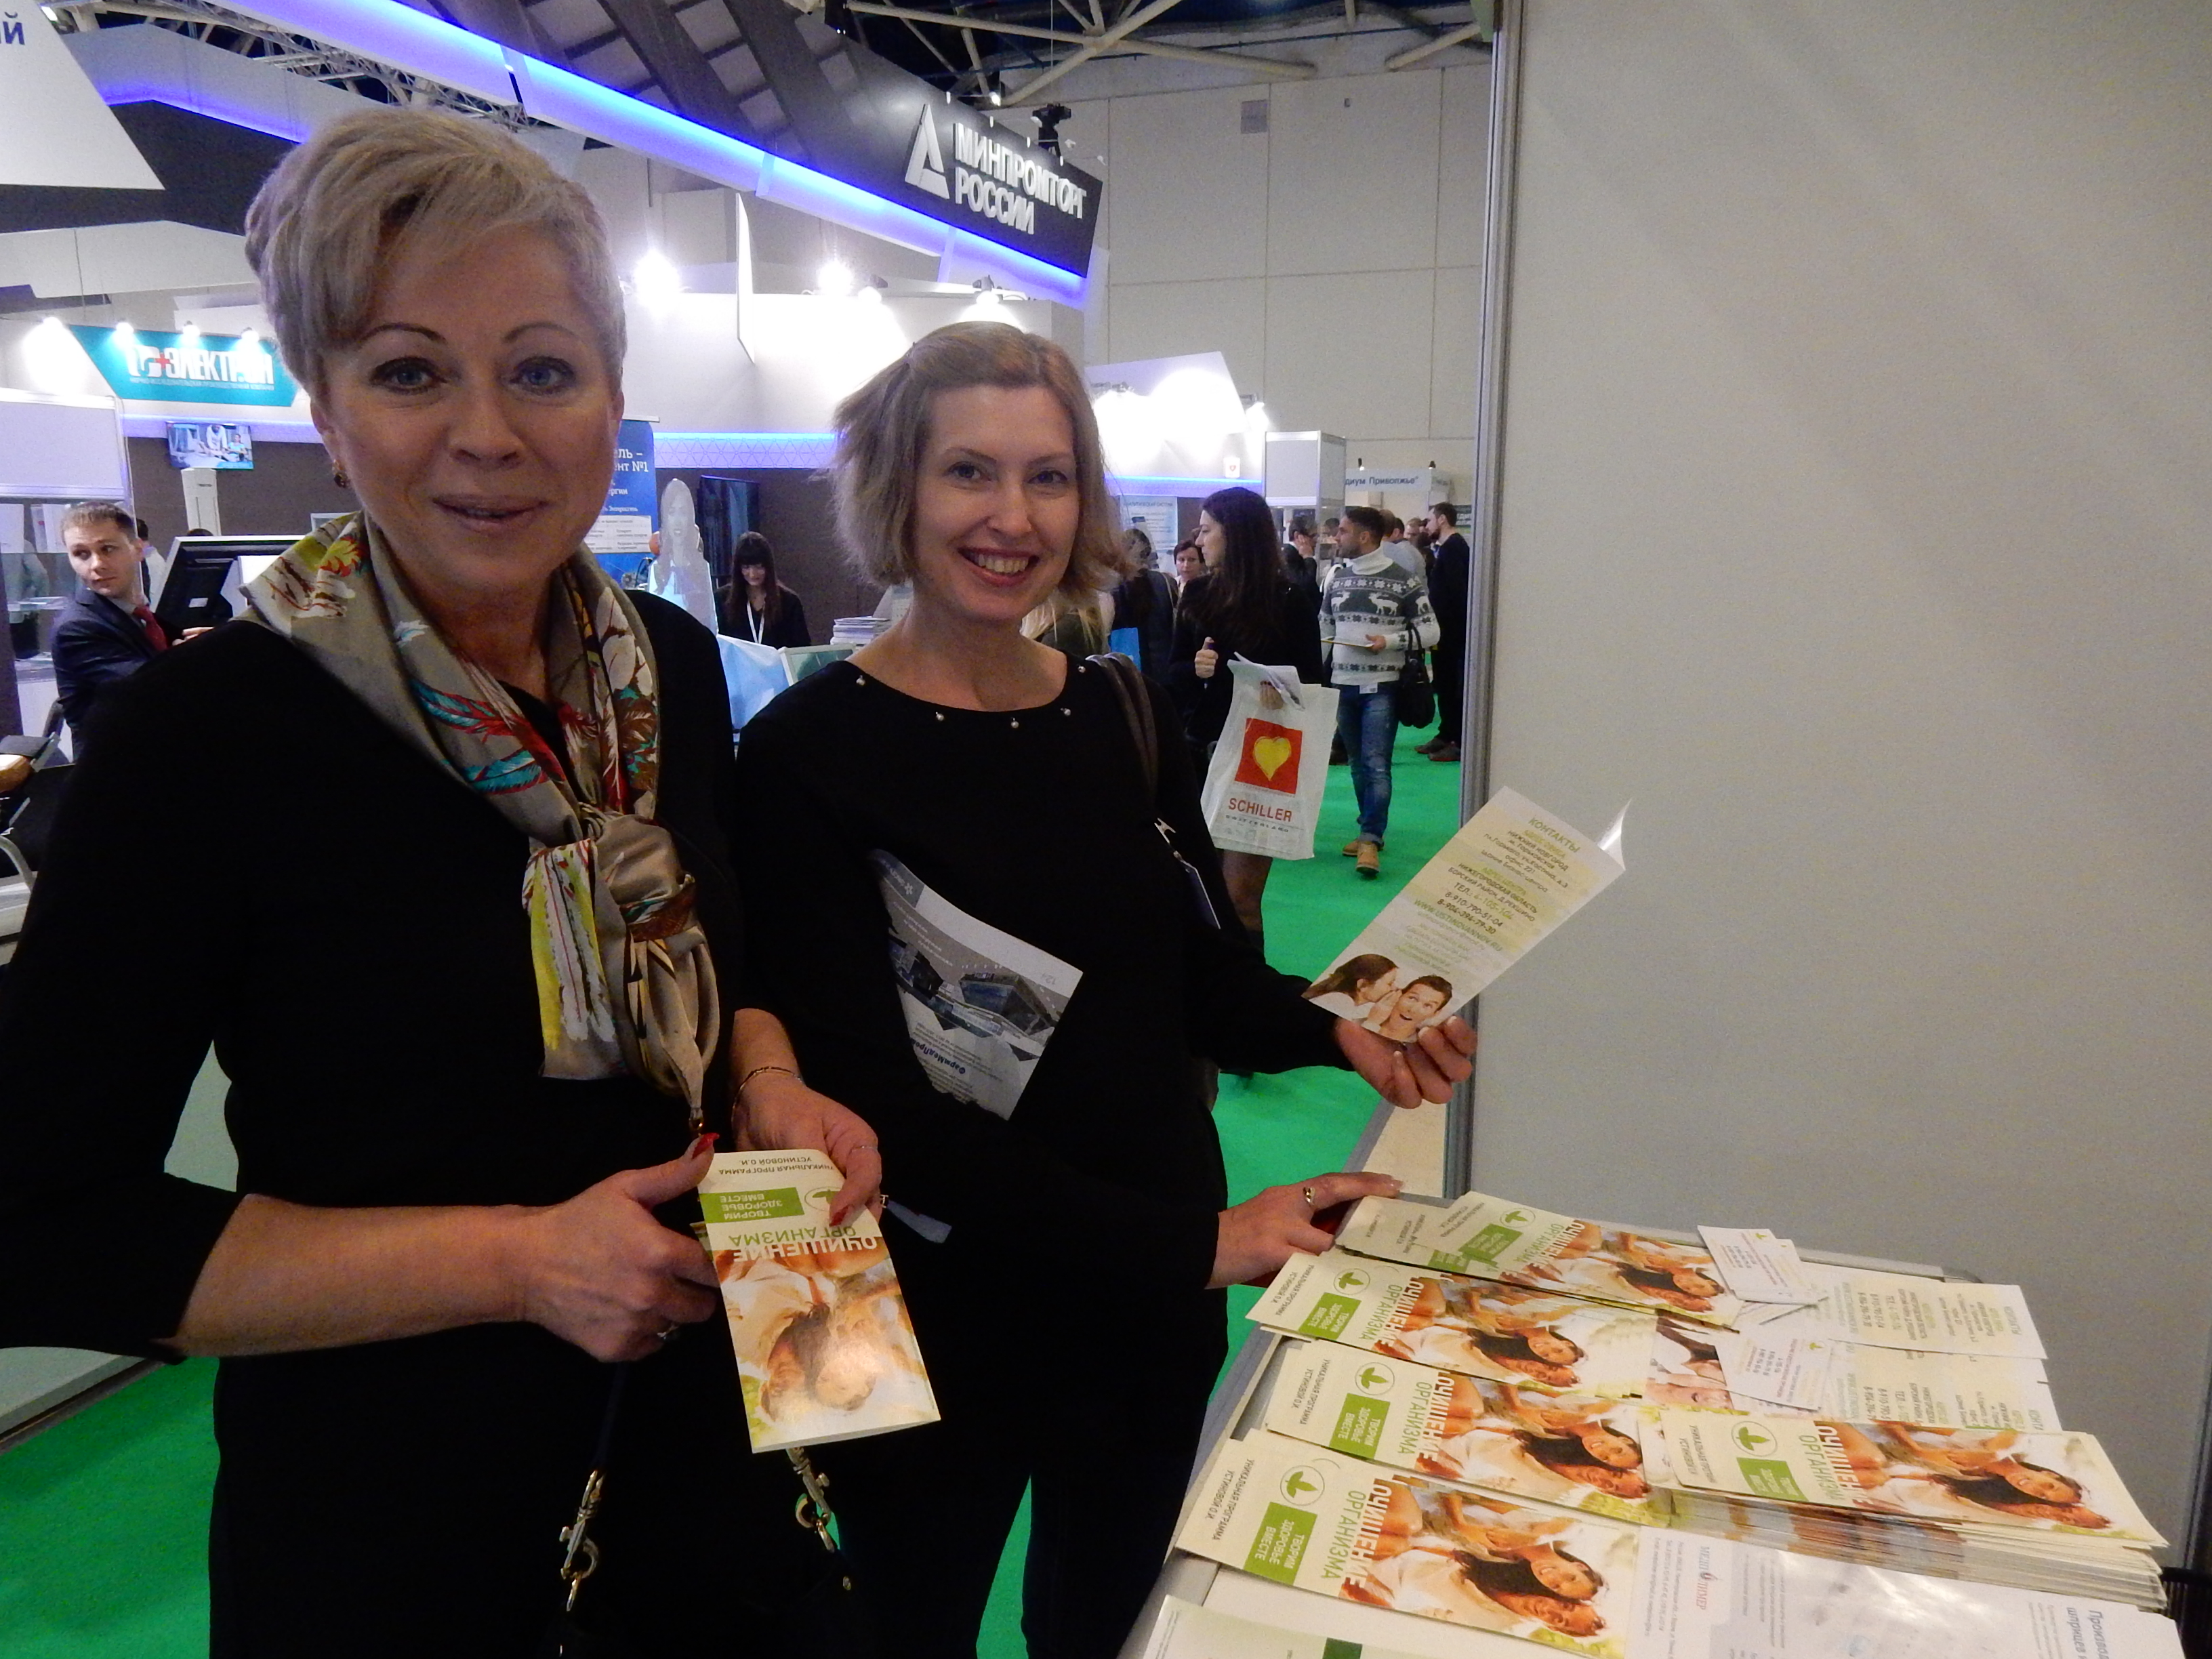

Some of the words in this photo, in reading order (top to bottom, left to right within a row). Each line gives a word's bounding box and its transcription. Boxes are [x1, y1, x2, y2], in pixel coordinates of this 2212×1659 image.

[955, 123, 1087, 219] МИНПРОМТОРГ
[956, 167, 1035, 234] РОССИИ
[164, 348, 274, 384] ЭЛЕКТН
[1228, 798, 1292, 822] SCHILLER
[1507, 828, 1536, 850] НИЖНИЙ
[1528, 816, 1580, 854] КОНТАКТЫ
[1447, 865, 1478, 886] БОРСКИЙ
[1444, 890, 1504, 928] 8-910-790-51-04
[718, 1165, 775, 1175] ПРОГРАММА
[758, 1155, 812, 1166] УСТИНОВОЙ
[718, 1192, 764, 1203] ВМЕСТЕ
[720, 1199, 782, 1211] ЗДОРОВЬЕ
[722, 1209, 771, 1220] ТВОРИМ
[727, 1225, 856, 1247] ОРГАНИЗМА
[731, 1235, 877, 1262] ОЧИЩЕНИЕ
[1358, 1283, 1404, 1343] ОРГАНИЗМА
[1376, 1279, 1426, 1347] ОЧИЩЕНИЕ
[1294, 1367, 1315, 1399] УСТИНОВОЙ
[1336, 1411, 1356, 1440] ВМЕСТЕ
[1361, 1416, 1381, 1446] ТВОРИМ
[1397, 1379, 1433, 1457] ОРГАНИЗМА
[1418, 1374, 1456, 1462] ОЧИЩЕНИЕ
[1210, 1468, 1236, 1509] УСТИНОВОЙ
[1229, 1457, 1255, 1501] УНИКАЛЬНАЯ
[1210, 1500, 1237, 1542] ПРОГРАММА
[1320, 1488, 1367, 1583] ОРГАНИЗМА
[1343, 1482, 1393, 1589] ОЧИЩЕНИЕ
[1254, 1525, 1277, 1561] ВМЕСТЕ
[1267, 1518, 1295, 1565] ЗДОРОВЬЕ
[1282, 1532, 1305, 1570] ТВОРИМ
